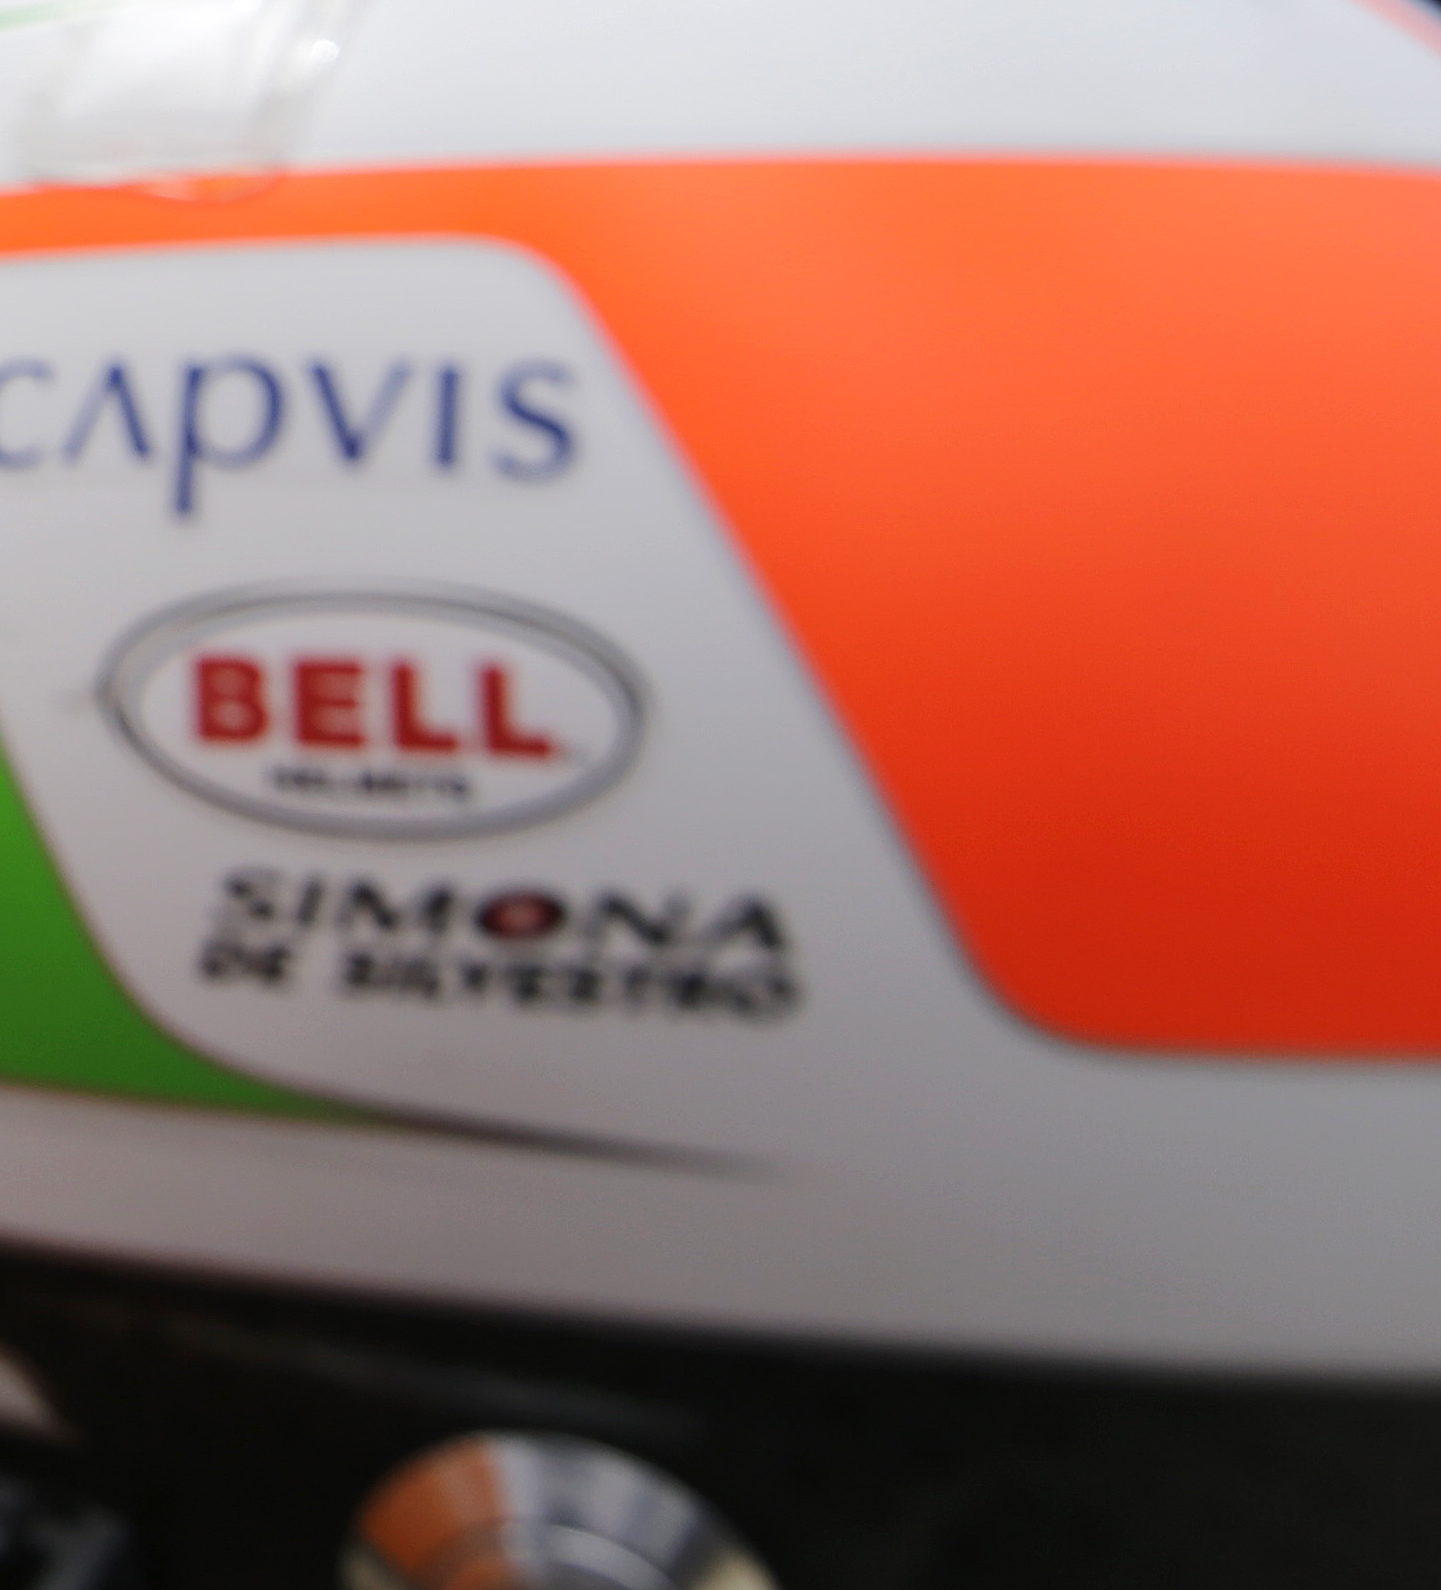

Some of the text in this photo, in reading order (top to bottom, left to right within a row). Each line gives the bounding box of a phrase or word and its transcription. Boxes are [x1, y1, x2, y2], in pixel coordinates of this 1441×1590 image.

[194, 658, 553, 760] BELL
[219, 872, 785, 951] SIMONA
[199, 940, 291, 984] DE
